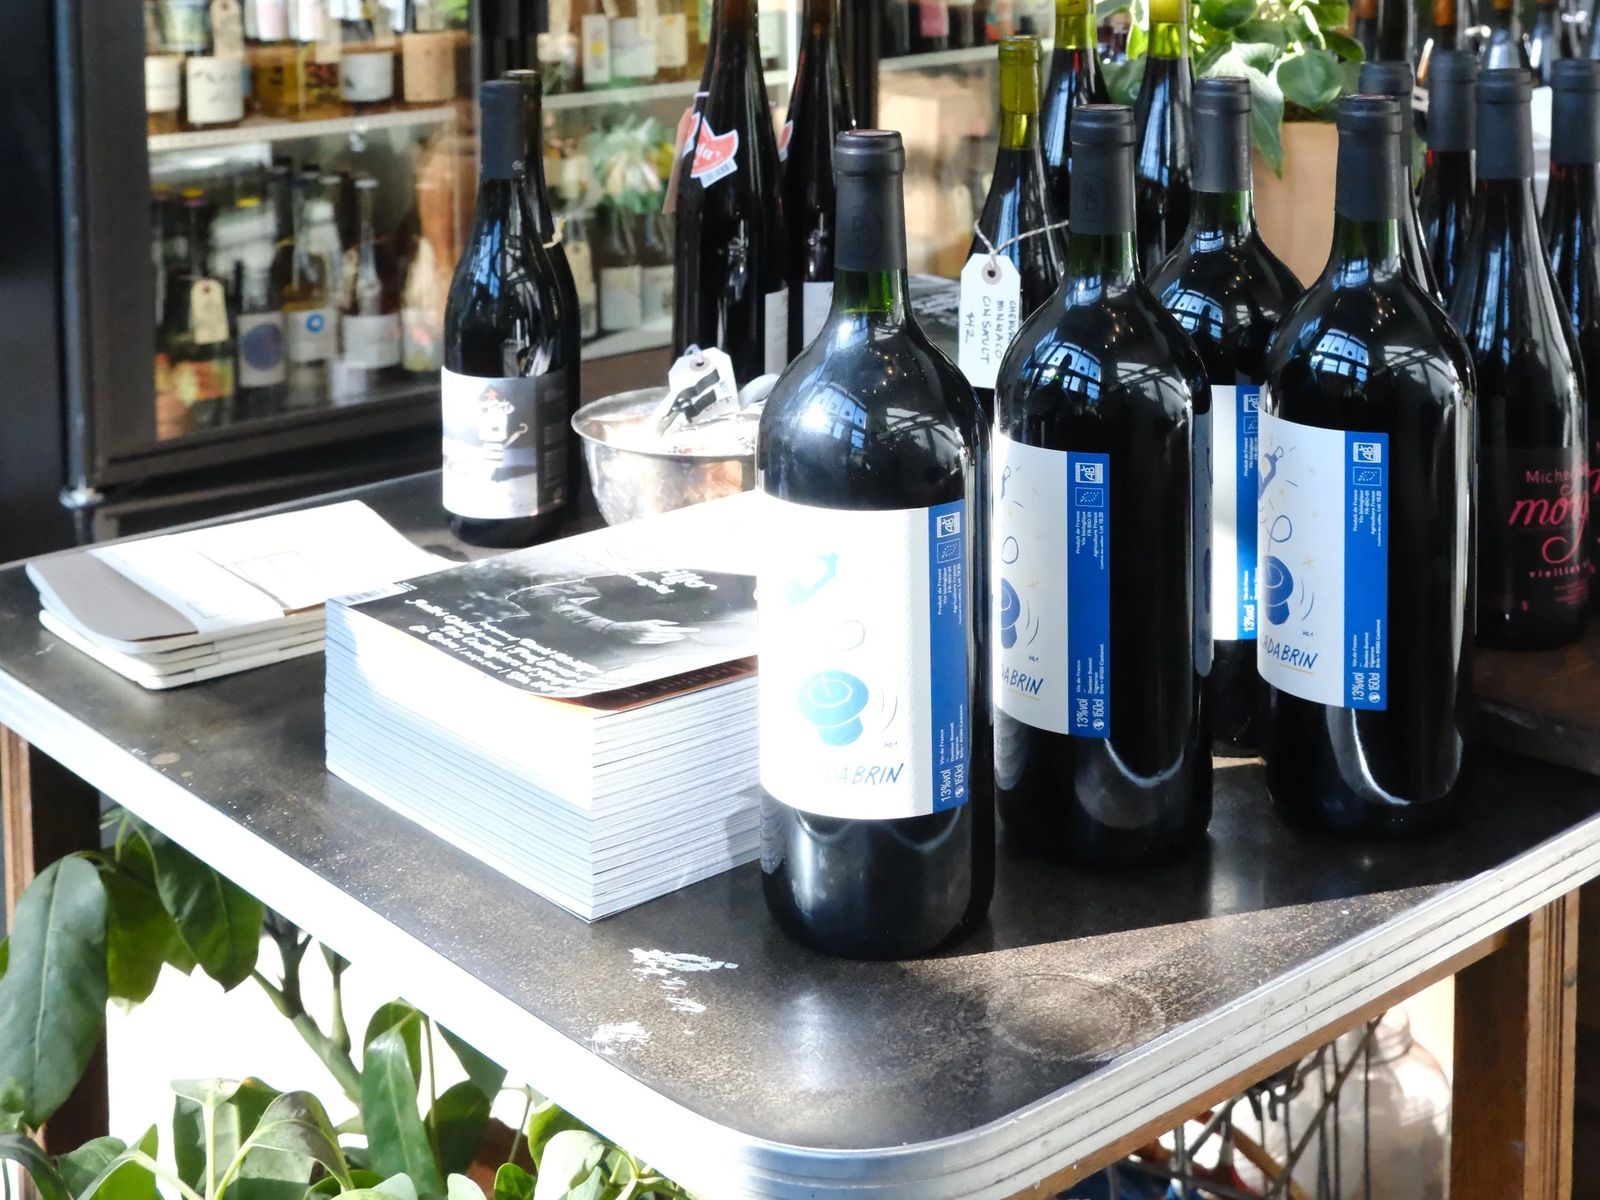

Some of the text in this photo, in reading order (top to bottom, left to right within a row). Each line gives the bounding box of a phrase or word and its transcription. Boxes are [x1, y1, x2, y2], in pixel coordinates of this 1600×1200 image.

[1076, 698, 1088, 728] 13%vol
[940, 768, 952, 802] 13%vol
[954, 763, 964, 785] 150cl
